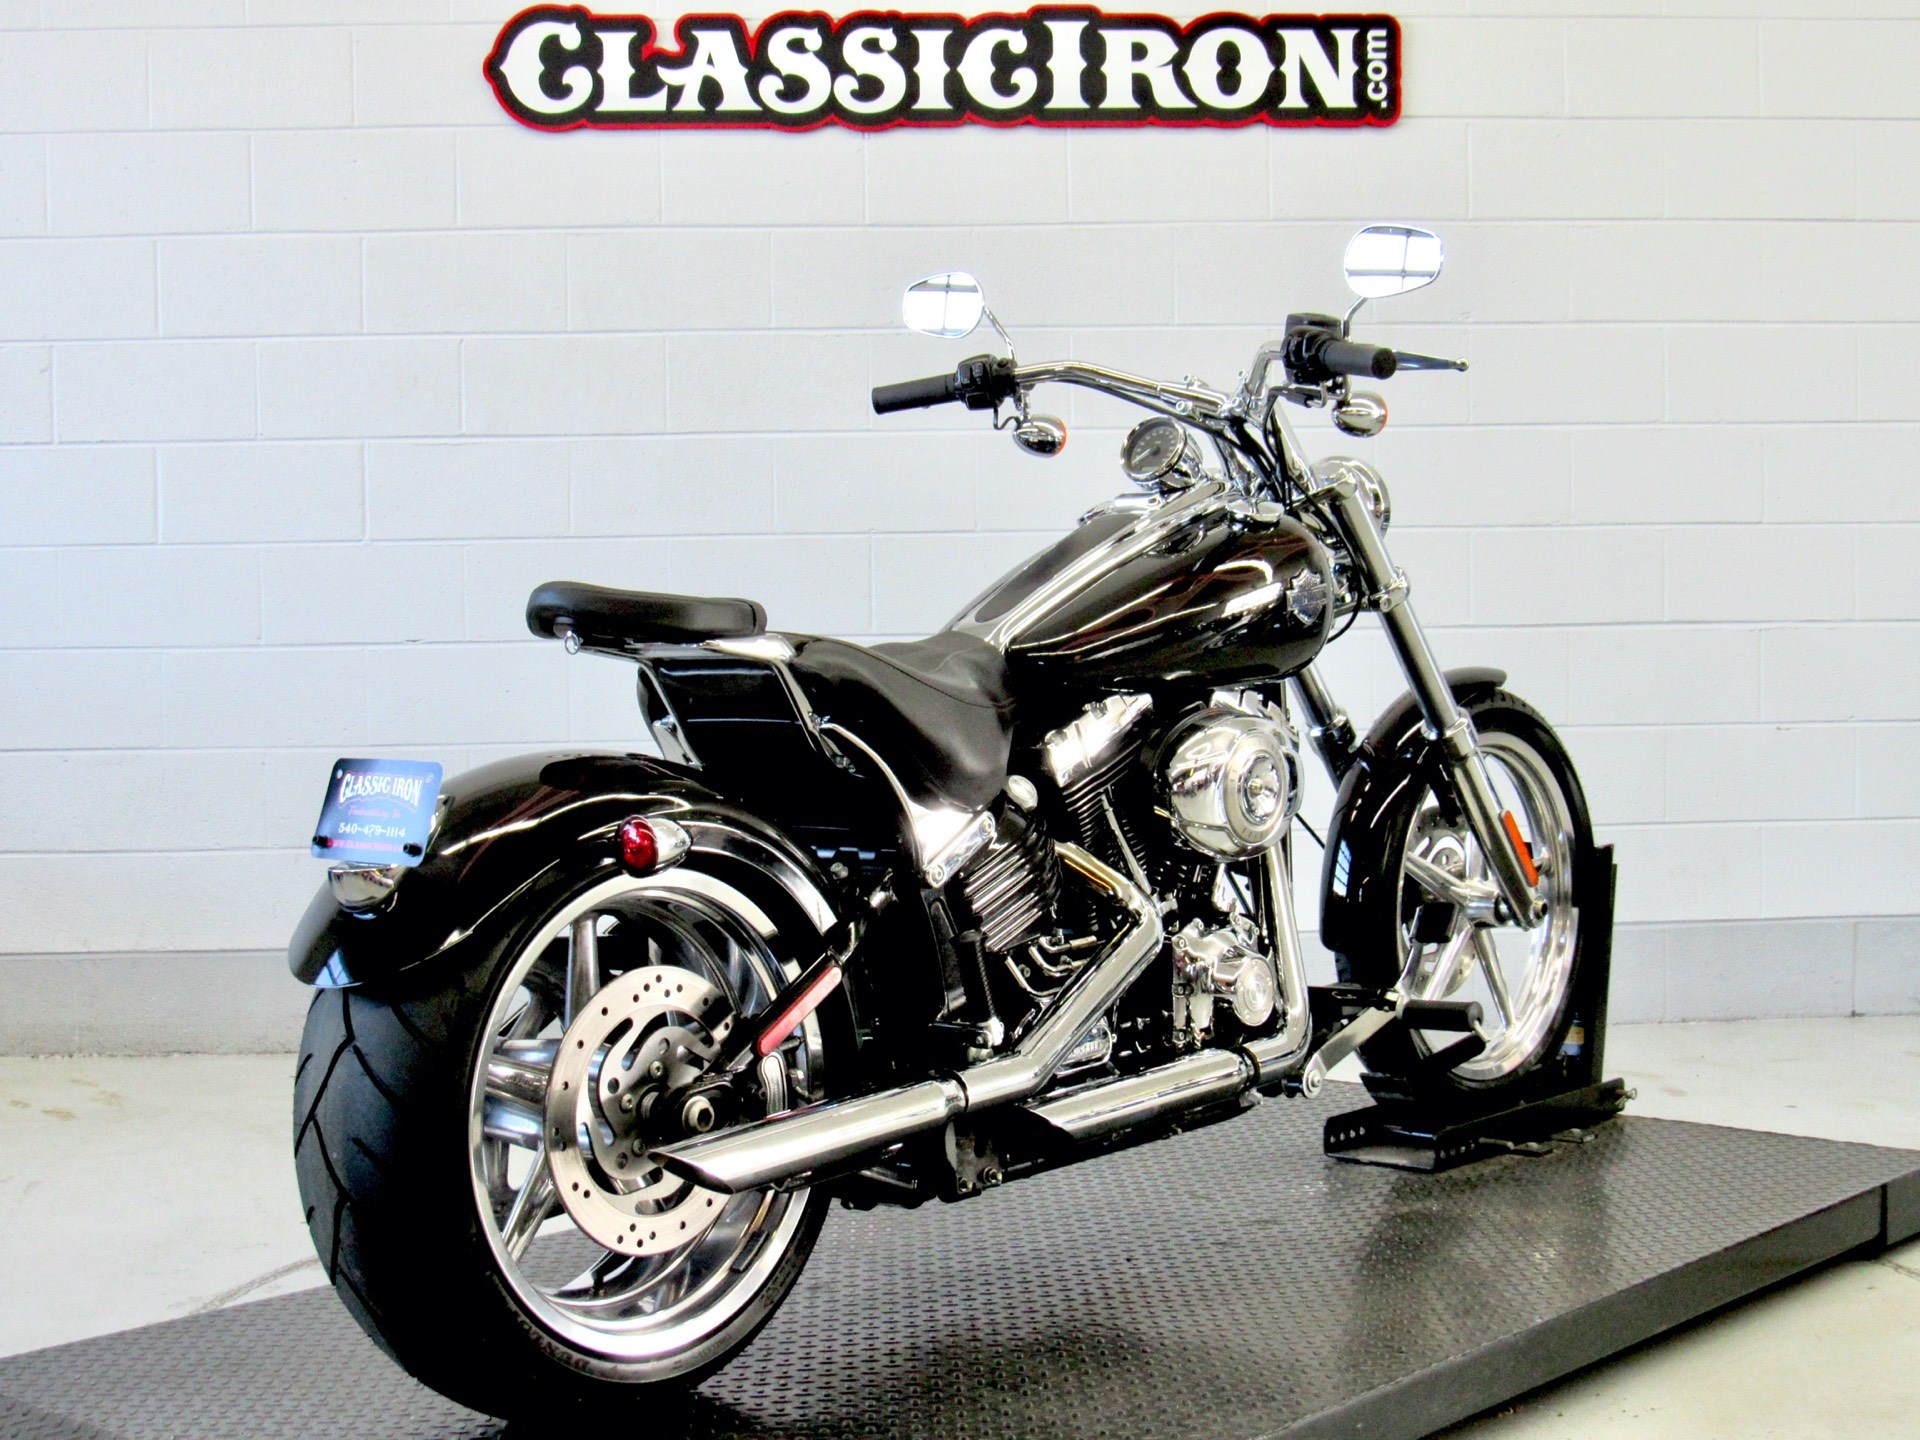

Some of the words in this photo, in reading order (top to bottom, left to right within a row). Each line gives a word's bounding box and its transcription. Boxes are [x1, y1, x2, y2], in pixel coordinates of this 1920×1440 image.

[1366, 28, 1388, 109] .com
[339, 773, 391, 803] CLASSIC
[391, 777, 423, 806] IRON
[338, 822, 406, 838] 540-479-1114
